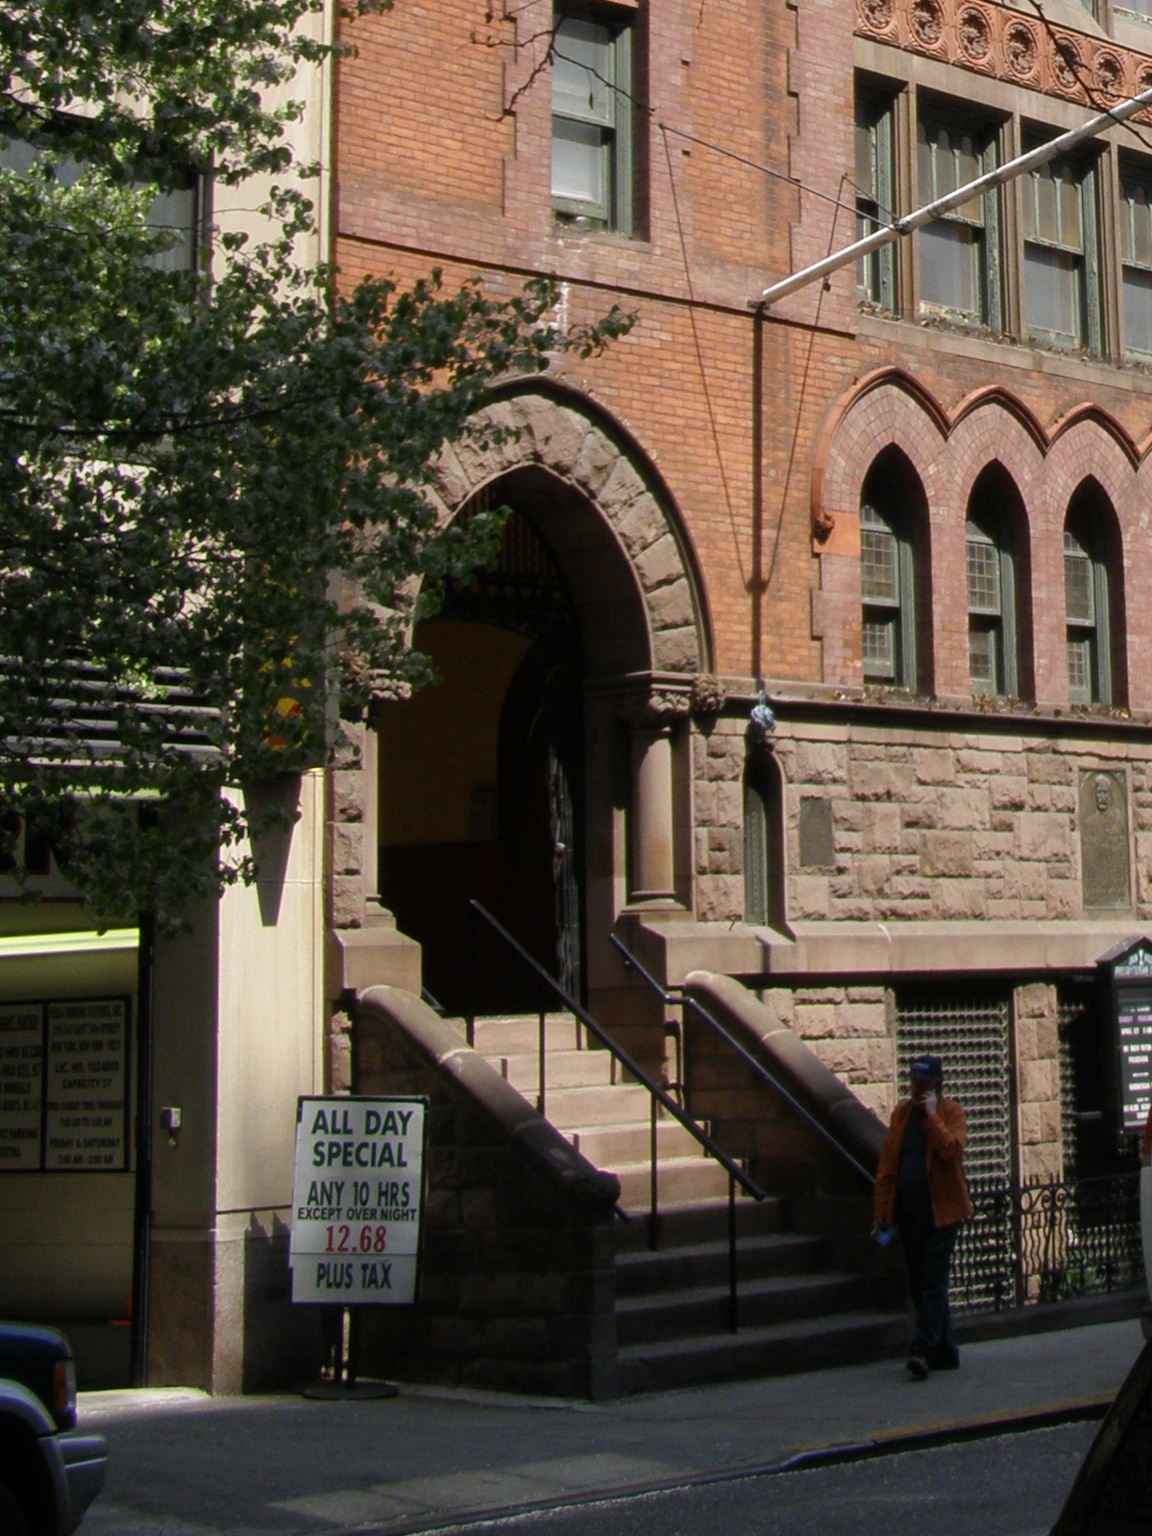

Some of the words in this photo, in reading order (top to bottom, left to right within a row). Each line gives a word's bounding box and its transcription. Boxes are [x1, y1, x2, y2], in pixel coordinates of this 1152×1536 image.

[311, 1109, 353, 1135] ALL
[365, 1110, 414, 1135] DAY
[312, 1141, 408, 1167] SPECIAL
[307, 1181, 345, 1207] ANY
[353, 1181, 370, 1207] 10
[377, 1181, 410, 1207] HRS
[298, 1207, 342, 1221] EXCEPT
[346, 1207, 377, 1221] OVER
[380, 1208, 417, 1221] NIGHT
[325, 1224, 387, 1252] 12.68
[316, 1263, 353, 1289] PLUS
[361, 1264, 392, 1289] TAX
